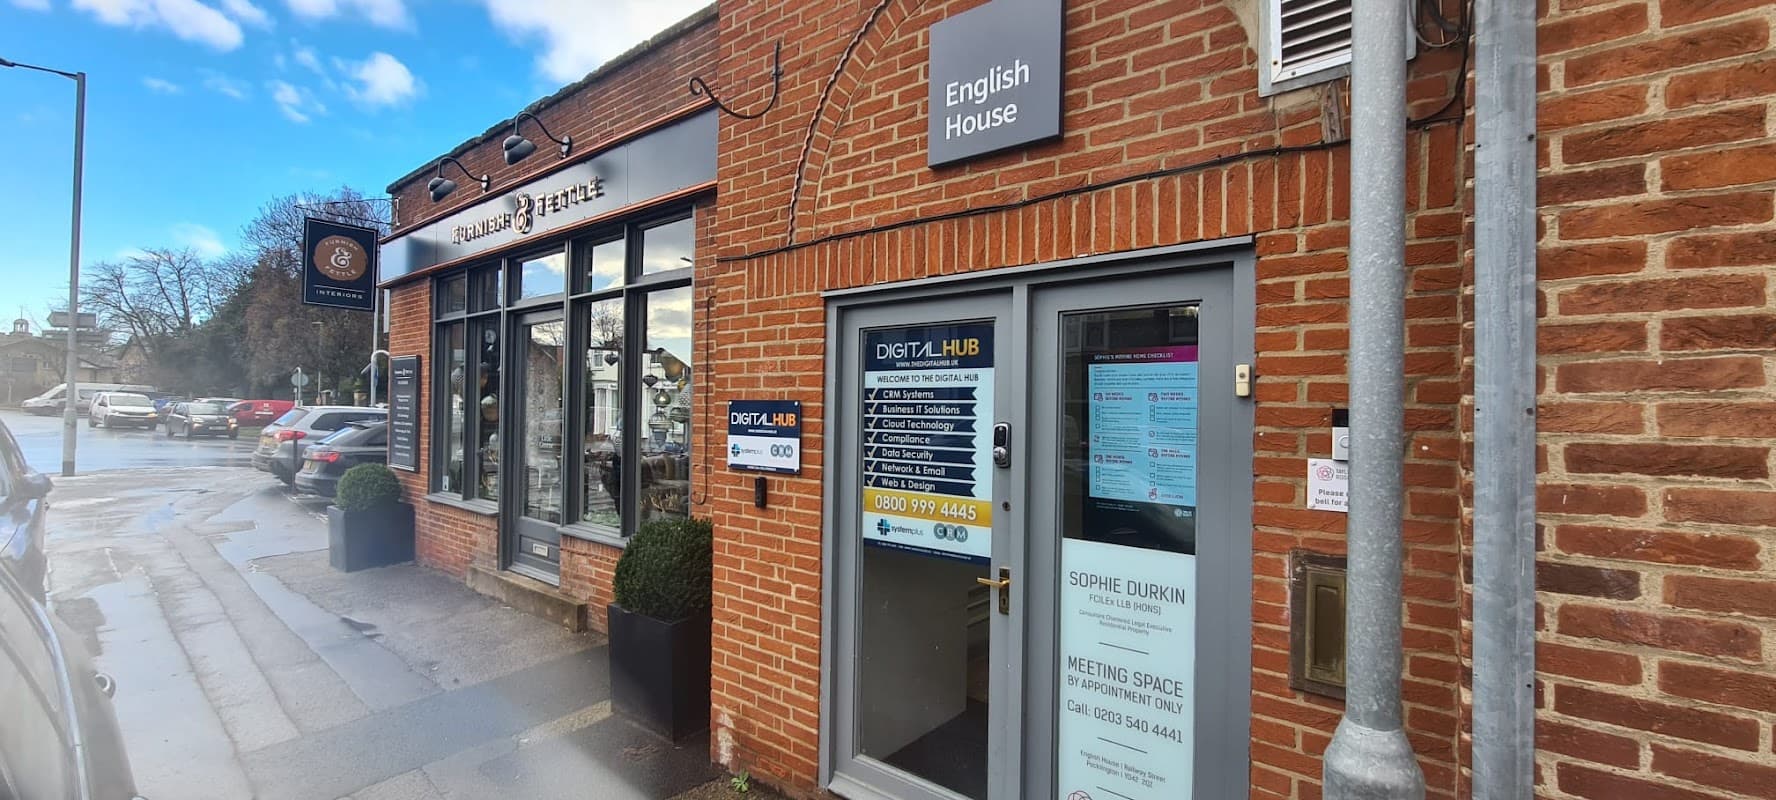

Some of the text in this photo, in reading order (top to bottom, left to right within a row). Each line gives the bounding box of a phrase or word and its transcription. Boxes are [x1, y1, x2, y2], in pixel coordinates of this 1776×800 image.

[945, 59, 1030, 107] English
[945, 103, 1018, 140] House
[451, 213, 508, 244] FURNISH
[535, 176, 604, 216] FETTLE
[330, 247, 352, 269] &
[324, 265, 357, 277] FETTLE
[315, 289, 363, 300] INTERIORS
[877, 375, 910, 383] WELCOME
[922, 374, 935, 382] THE
[935, 373, 962, 382] DIGITAL
[964, 373, 979, 381] HUB
[882, 389, 934, 400] CRM Systems
[882, 405, 960, 415] Business IT Solutions
[882, 419, 954, 431] Cloud Technology
[881, 433, 930, 445] Compliance
[881, 448, 933, 461] Data Security
[881, 463, 946, 476] Network & Email
[881, 478, 936, 492] Web & Design
[1318, 488, 1344, 497] Please
[875, 494, 977, 520] 0800 999 4445
[1315, 498, 1330, 506] bell
[1331, 498, 1342, 506] for
[891, 525, 924, 536] systemplus
[1069, 571, 1185, 605] SOPHIE DURKIN
[1089, 593, 1115, 607] FCILEx
[1116, 598, 1131, 609] LLB
[1068, 655, 1184, 698] MEETING SPACE
[1067, 674, 1183, 715] BY APPOINTMENT ONLY
[1067, 699, 1183, 744] Call: 0203 540 4441
